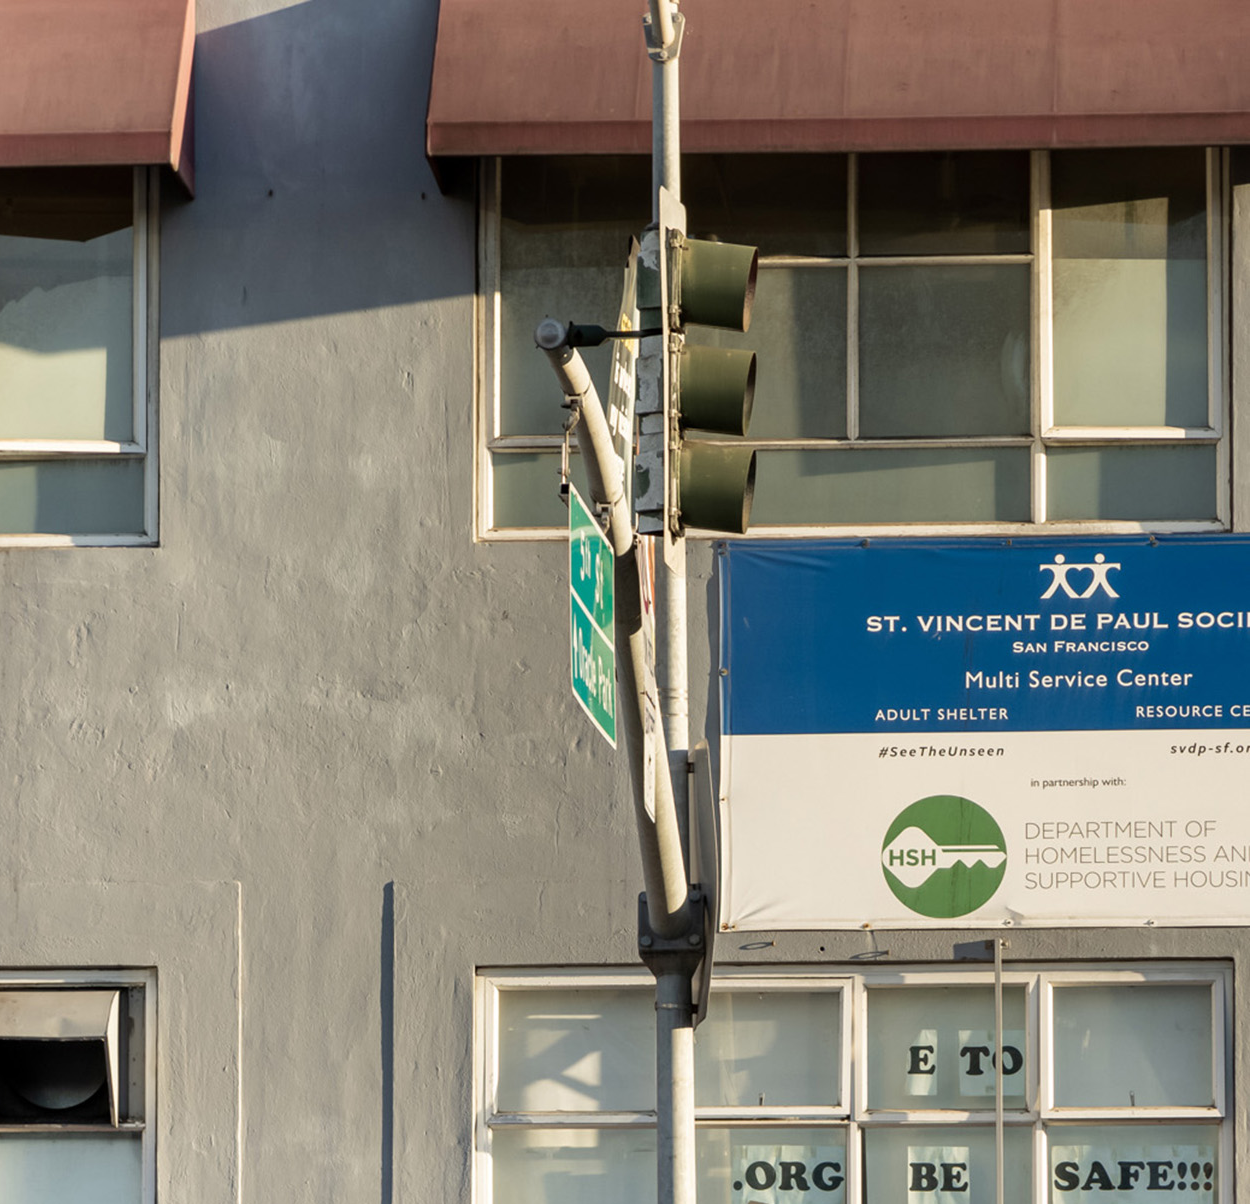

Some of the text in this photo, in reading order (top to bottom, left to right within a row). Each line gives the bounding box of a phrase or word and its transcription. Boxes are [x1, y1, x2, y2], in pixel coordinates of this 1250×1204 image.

[866, 615, 907, 632] ST.
[917, 614, 1041, 632] VINCENT
[1050, 613, 1086, 631] DE
[1097, 612, 1169, 630] PAUL
[965, 669, 1193, 688] Multi Service Center
[875, 708, 1008, 721] ADULT SHELTER
[1136, 704, 1250, 718] RESOURCE CE
[879, 746, 1005, 758] #SeeTheUnseen
[1031, 777, 1127, 789] in partnership with:
[1025, 820, 1217, 839] DEPARTMENT OF
[889, 849, 936, 866] HSH
[1025, 845, 1250, 864] HOMELESSNESS AN
[1025, 871, 1166, 889] SUPPORTIVE
[907, 1045, 1023, 1075] E TO
[733, 1161, 1213, 1192] .ORG BE SAFE!!!
